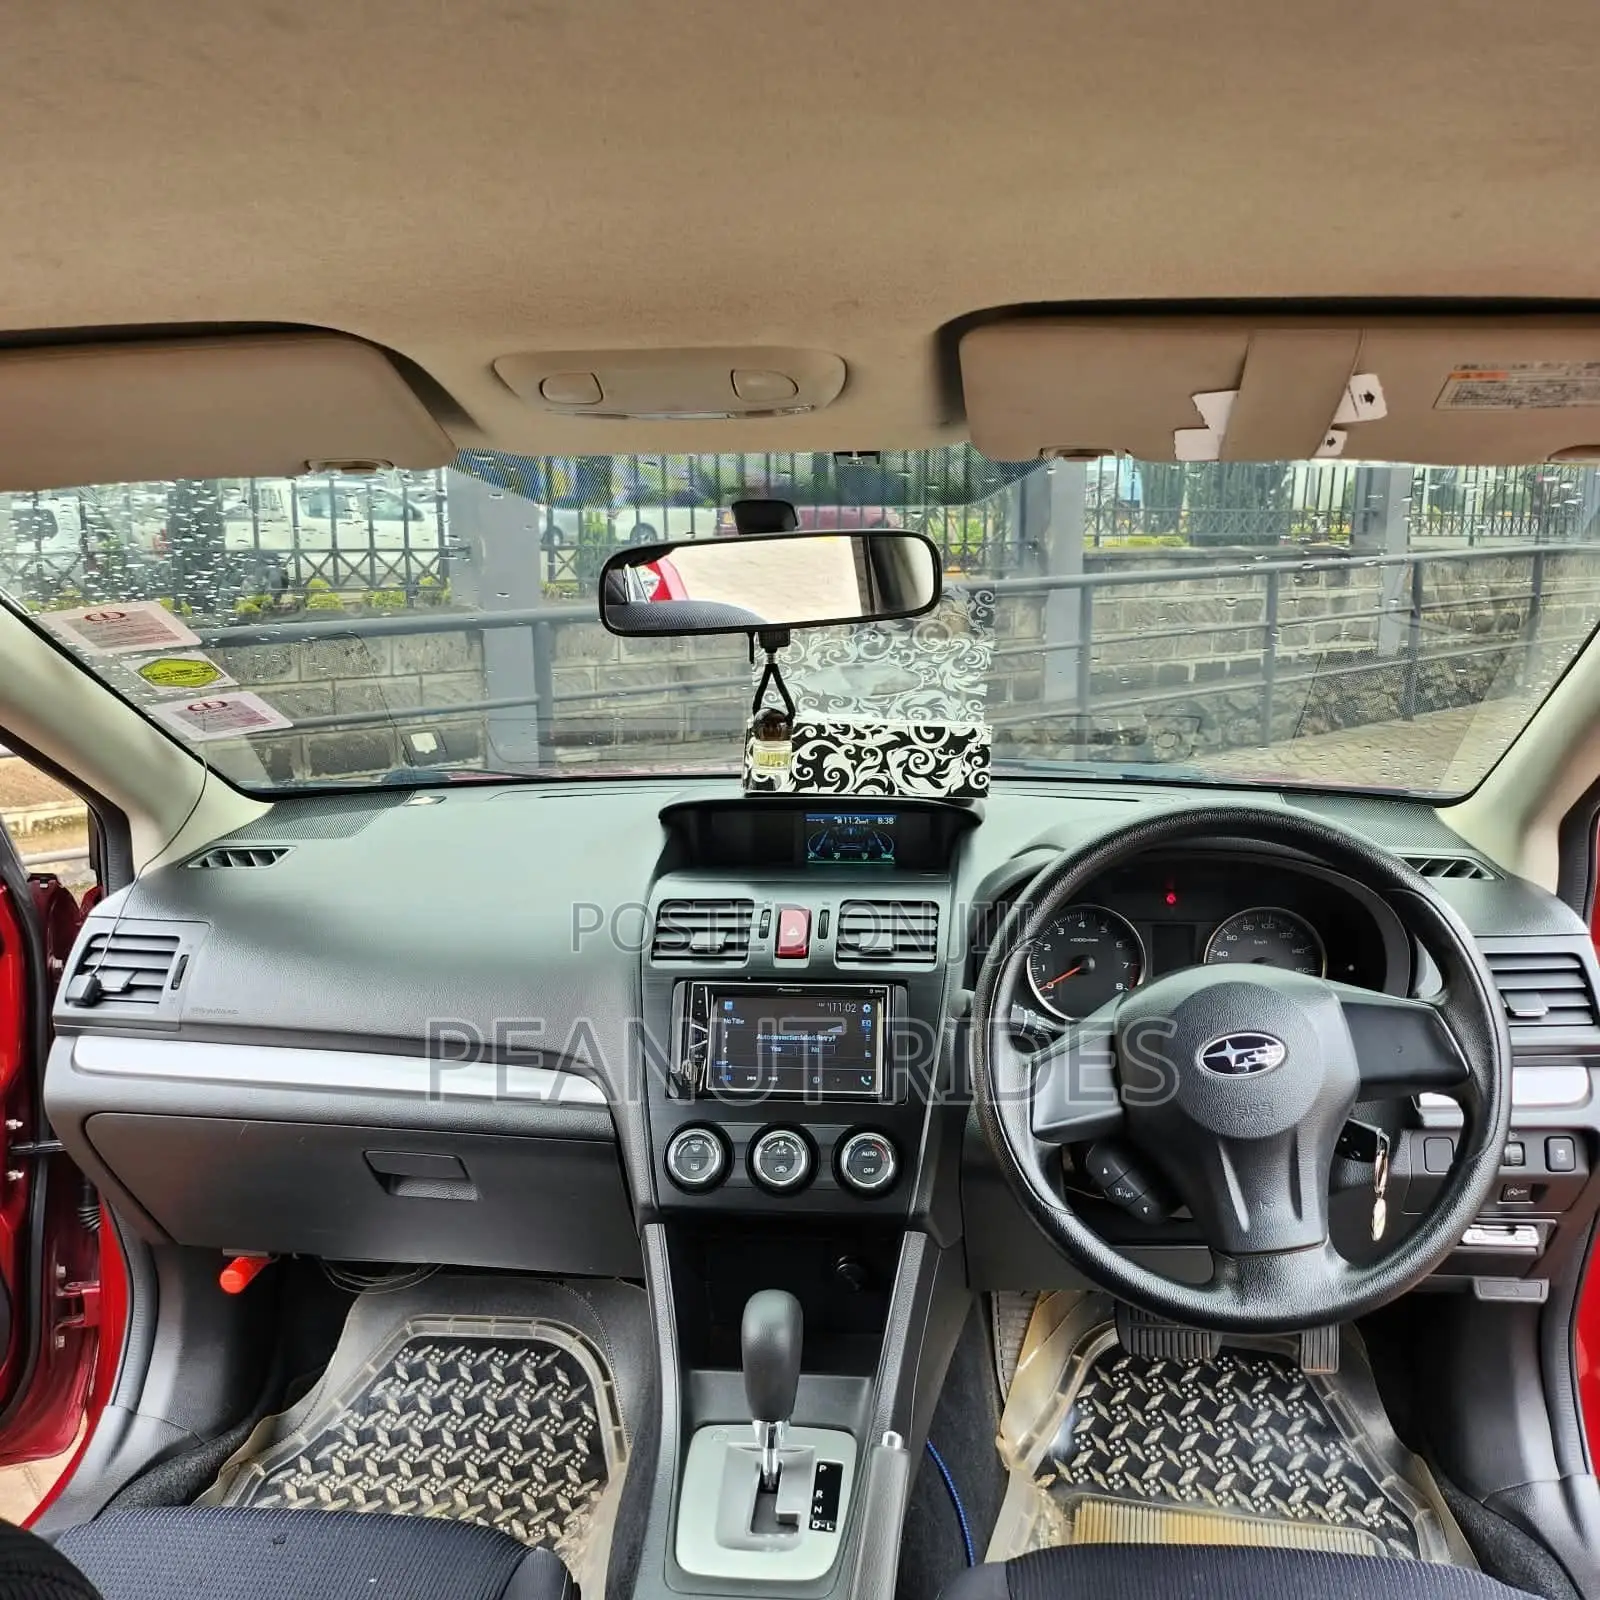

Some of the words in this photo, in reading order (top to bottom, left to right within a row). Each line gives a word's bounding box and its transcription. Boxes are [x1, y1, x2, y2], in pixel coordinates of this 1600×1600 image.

[818, 1464, 827, 1473] P
[815, 1490, 823, 1498] R
[814, 1505, 822, 1513] N
